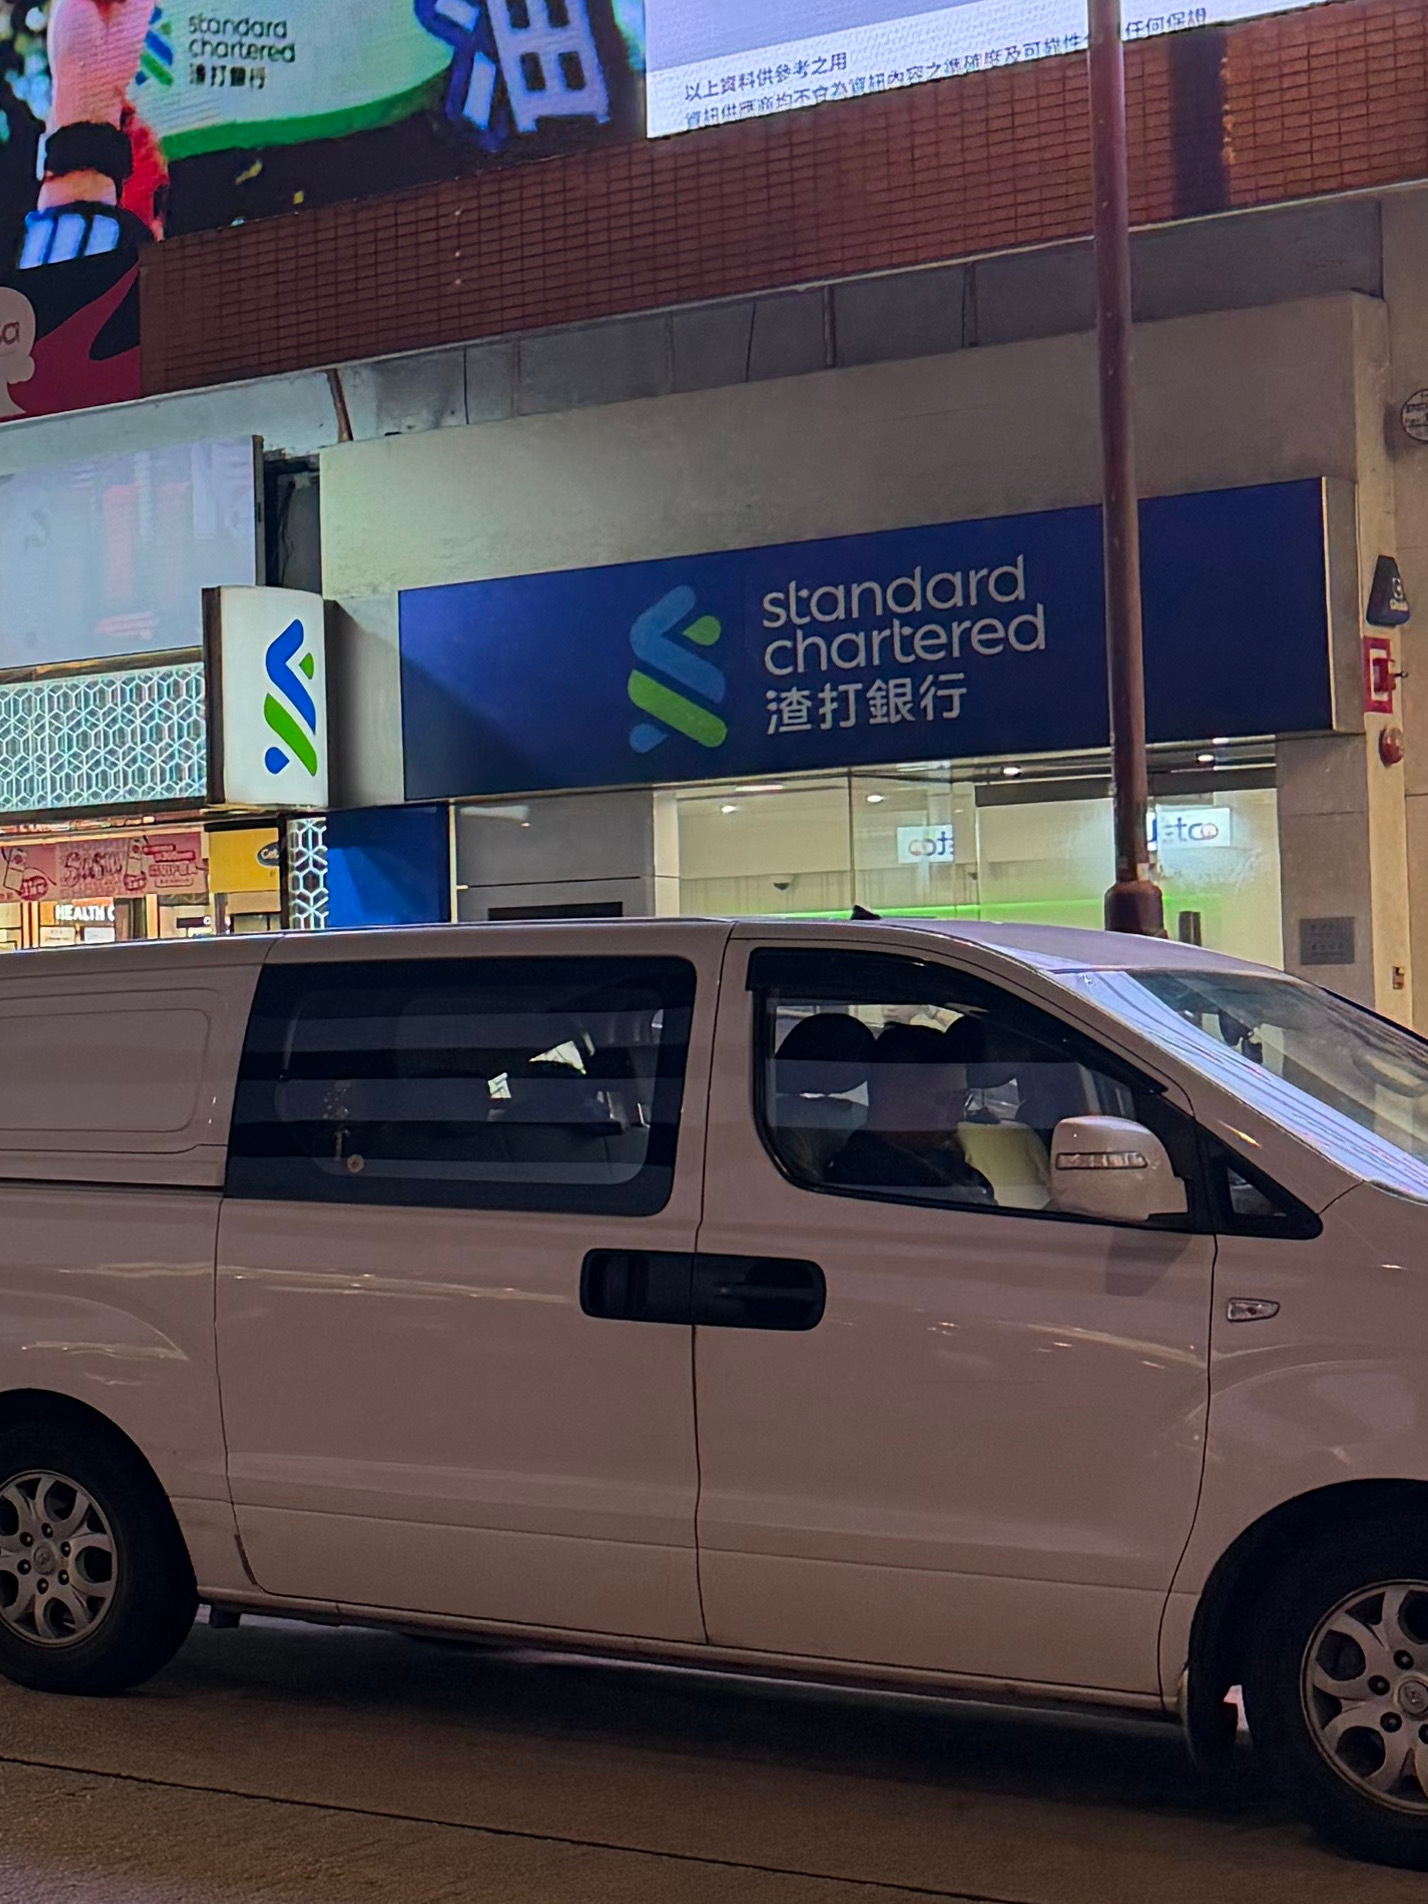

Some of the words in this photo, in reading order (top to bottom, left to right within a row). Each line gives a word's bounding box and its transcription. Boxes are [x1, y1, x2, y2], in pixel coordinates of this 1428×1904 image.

[189, 12, 288, 39] standard
[189, 37, 296, 64] chartered
[762, 554, 1026, 628] standard
[764, 602, 1046, 676] chartered
[766, 673, 968, 735] 渣打銀行
[55, 903, 105, 922] HEALTH
